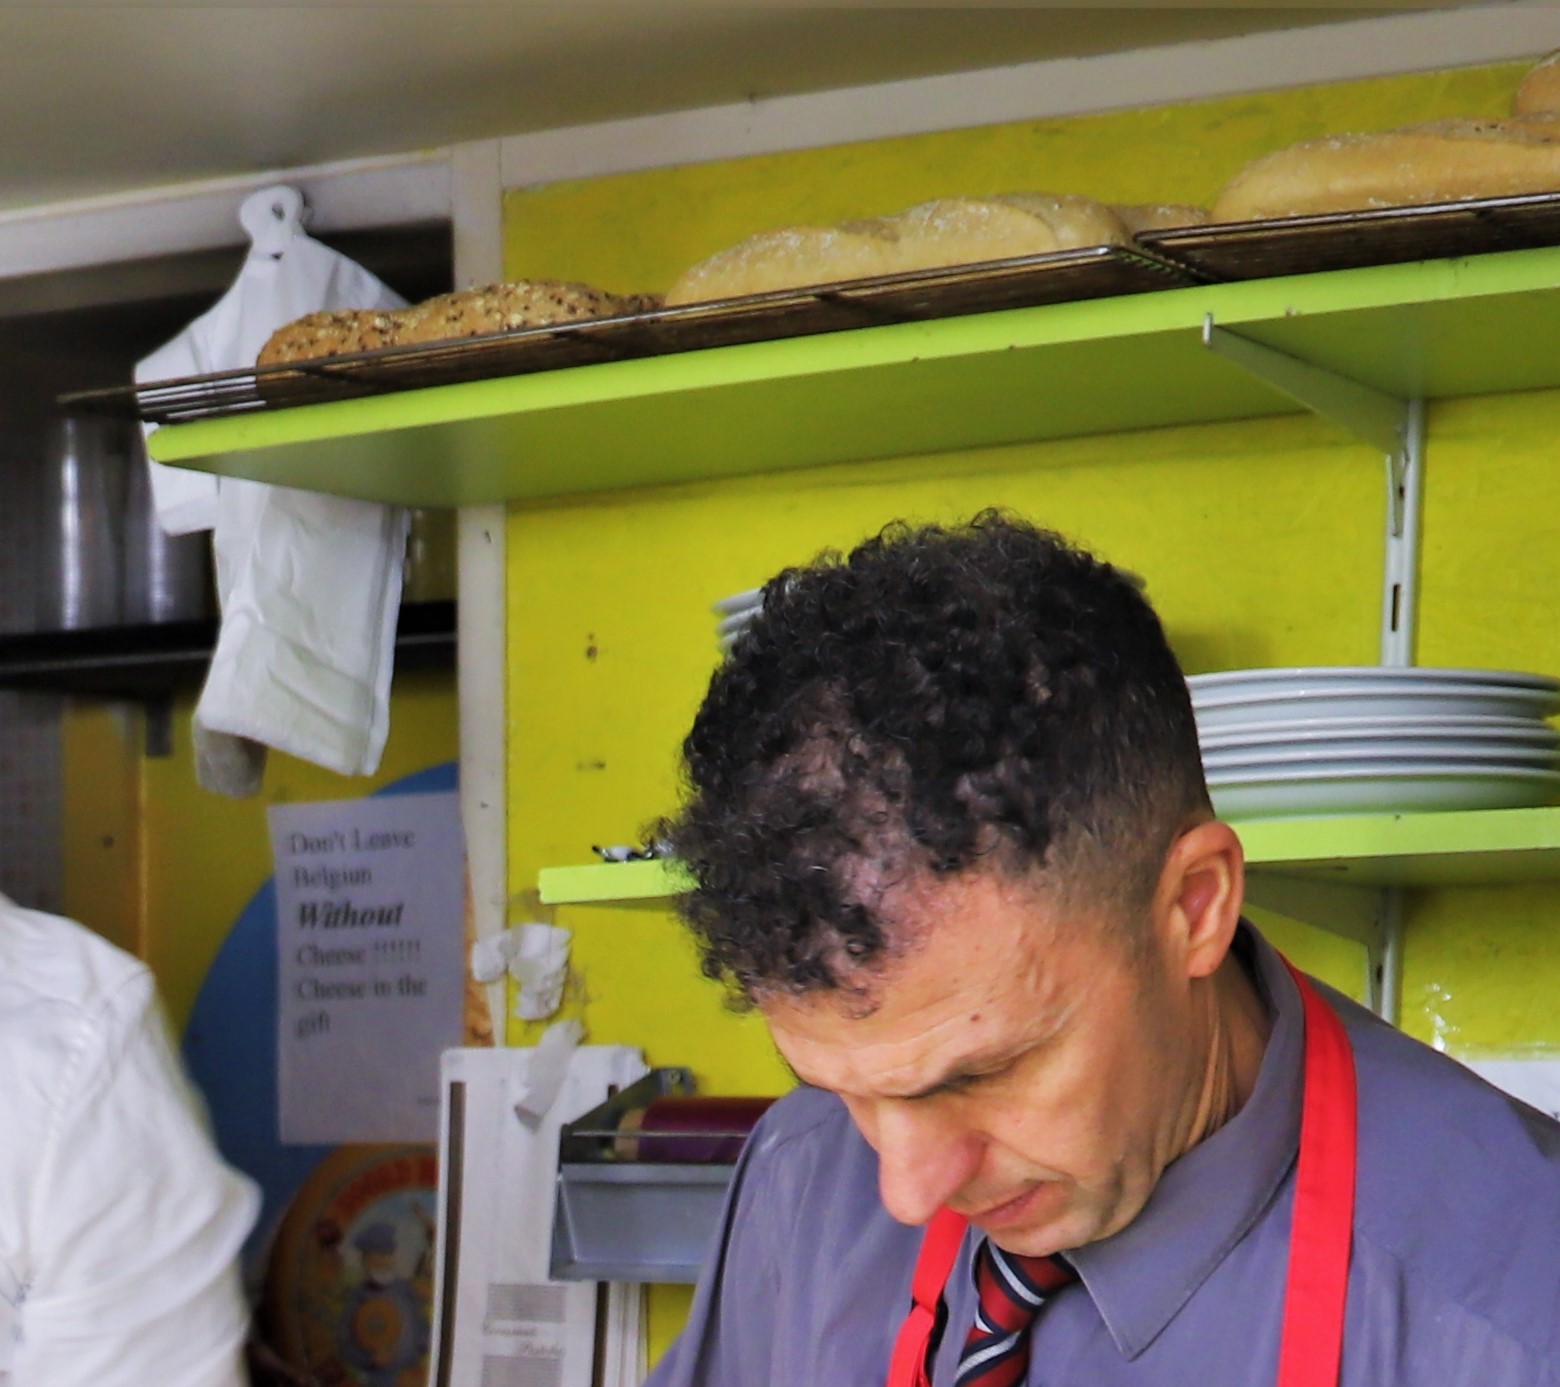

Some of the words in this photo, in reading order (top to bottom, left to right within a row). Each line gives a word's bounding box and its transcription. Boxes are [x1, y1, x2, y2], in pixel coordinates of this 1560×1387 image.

[289, 830, 345, 853] Don't
[353, 828, 415, 850] Leave
[297, 901, 404, 929] Without
[296, 945, 366, 967] Cheese
[296, 976, 365, 999] Cheese
[397, 973, 427, 997] the
